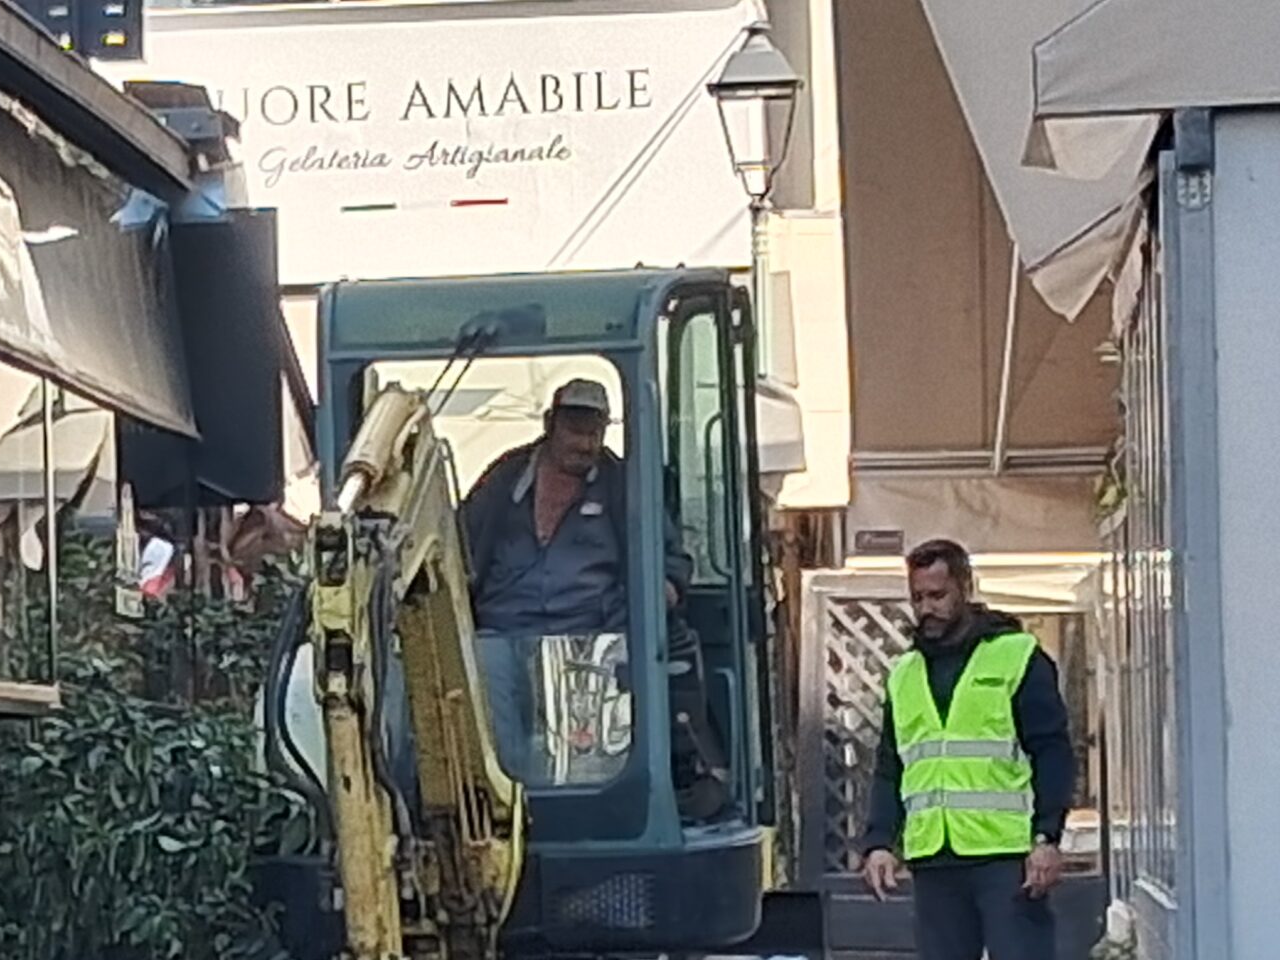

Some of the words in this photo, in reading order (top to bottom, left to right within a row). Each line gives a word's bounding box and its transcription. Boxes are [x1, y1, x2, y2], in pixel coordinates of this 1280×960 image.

[216, 81, 371, 126] UORE
[399, 68, 652, 121] AMABILE
[258, 145, 392, 189] Gelateria
[403, 134, 572, 179] Artigianale
